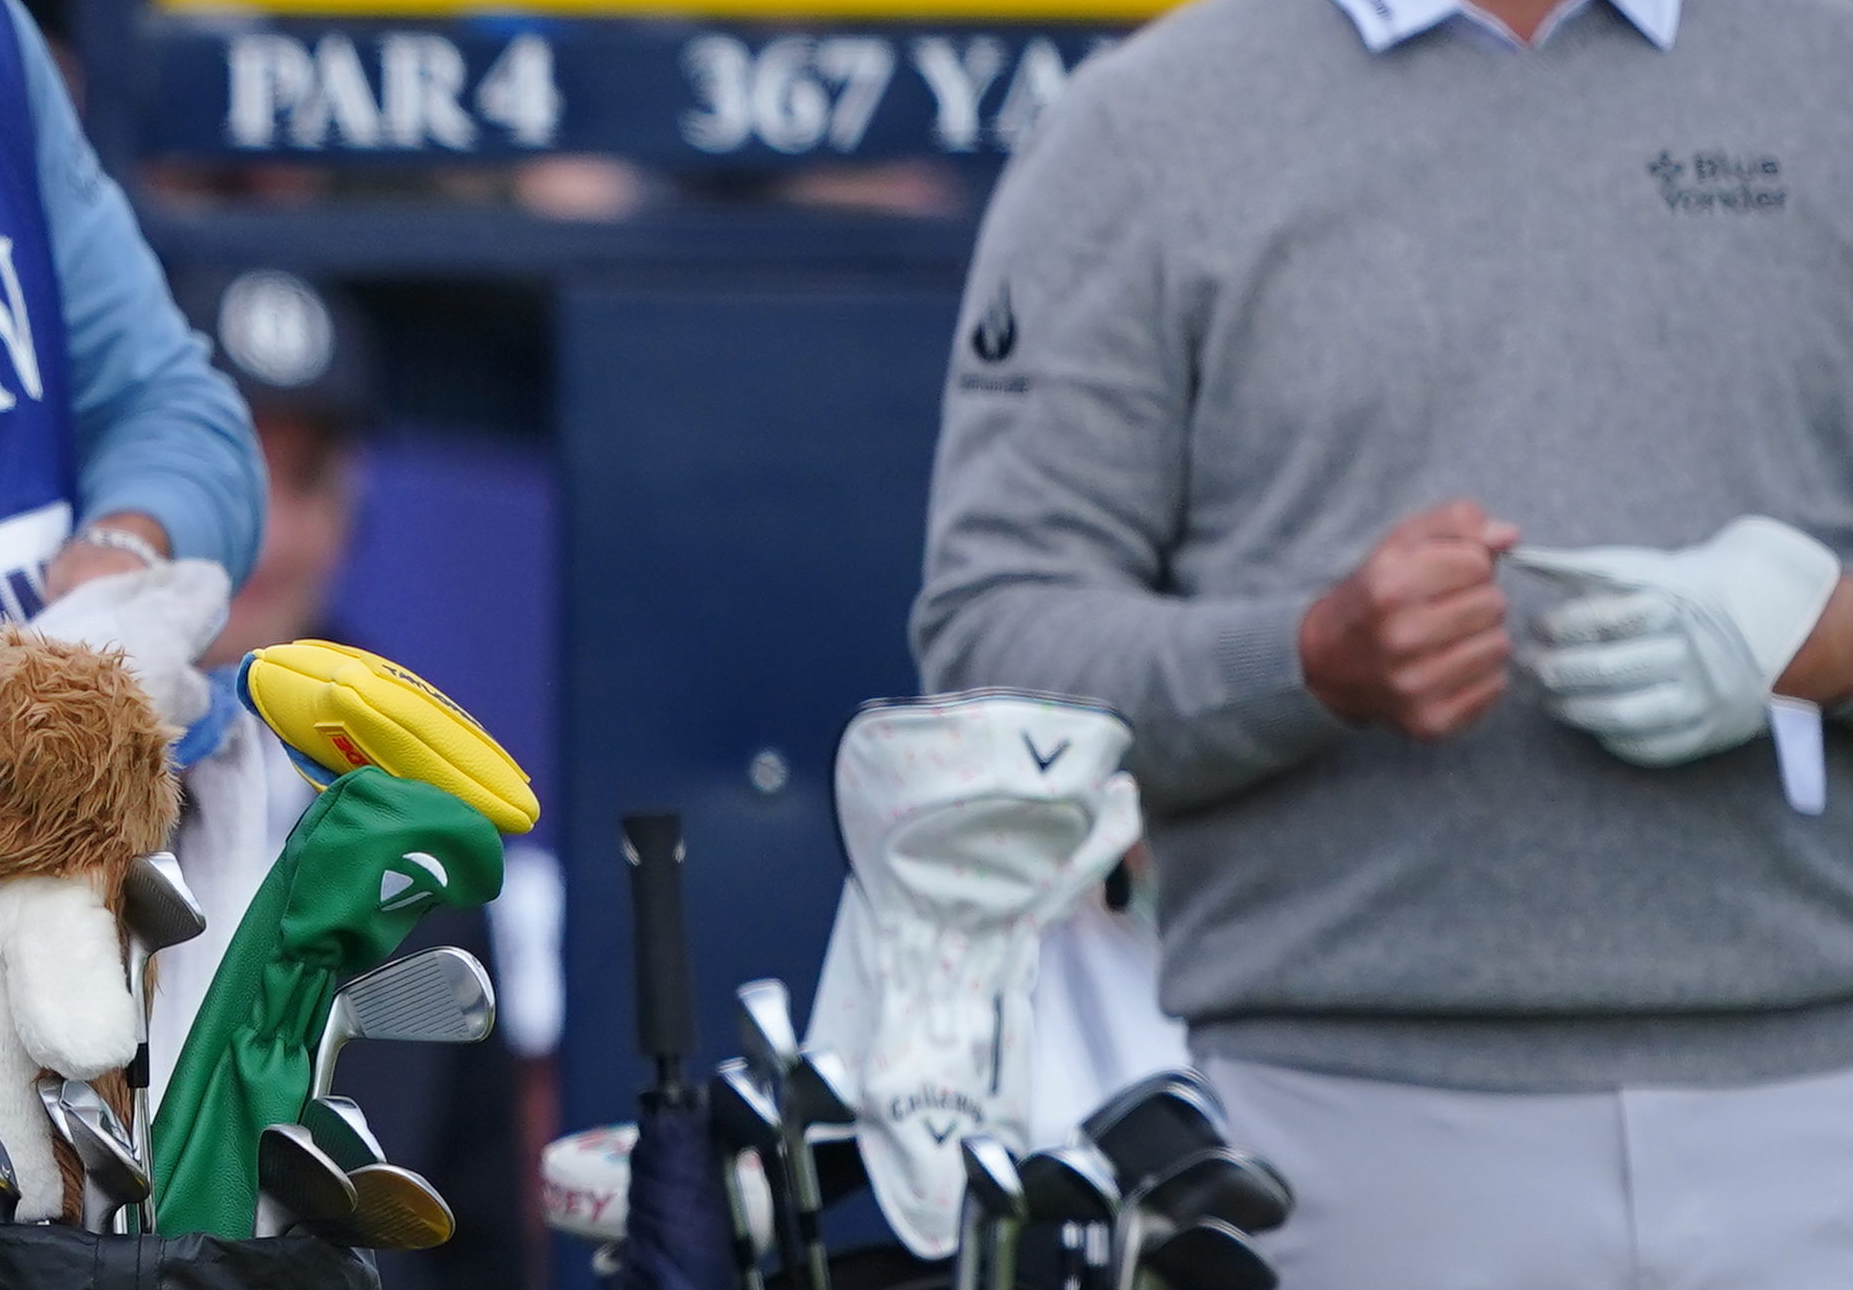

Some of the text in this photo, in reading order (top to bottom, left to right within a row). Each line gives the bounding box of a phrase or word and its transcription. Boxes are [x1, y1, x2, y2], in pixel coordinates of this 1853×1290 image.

[228, 34, 561, 150] PAR 4
[682, 31, 1120, 153] 367 YA
